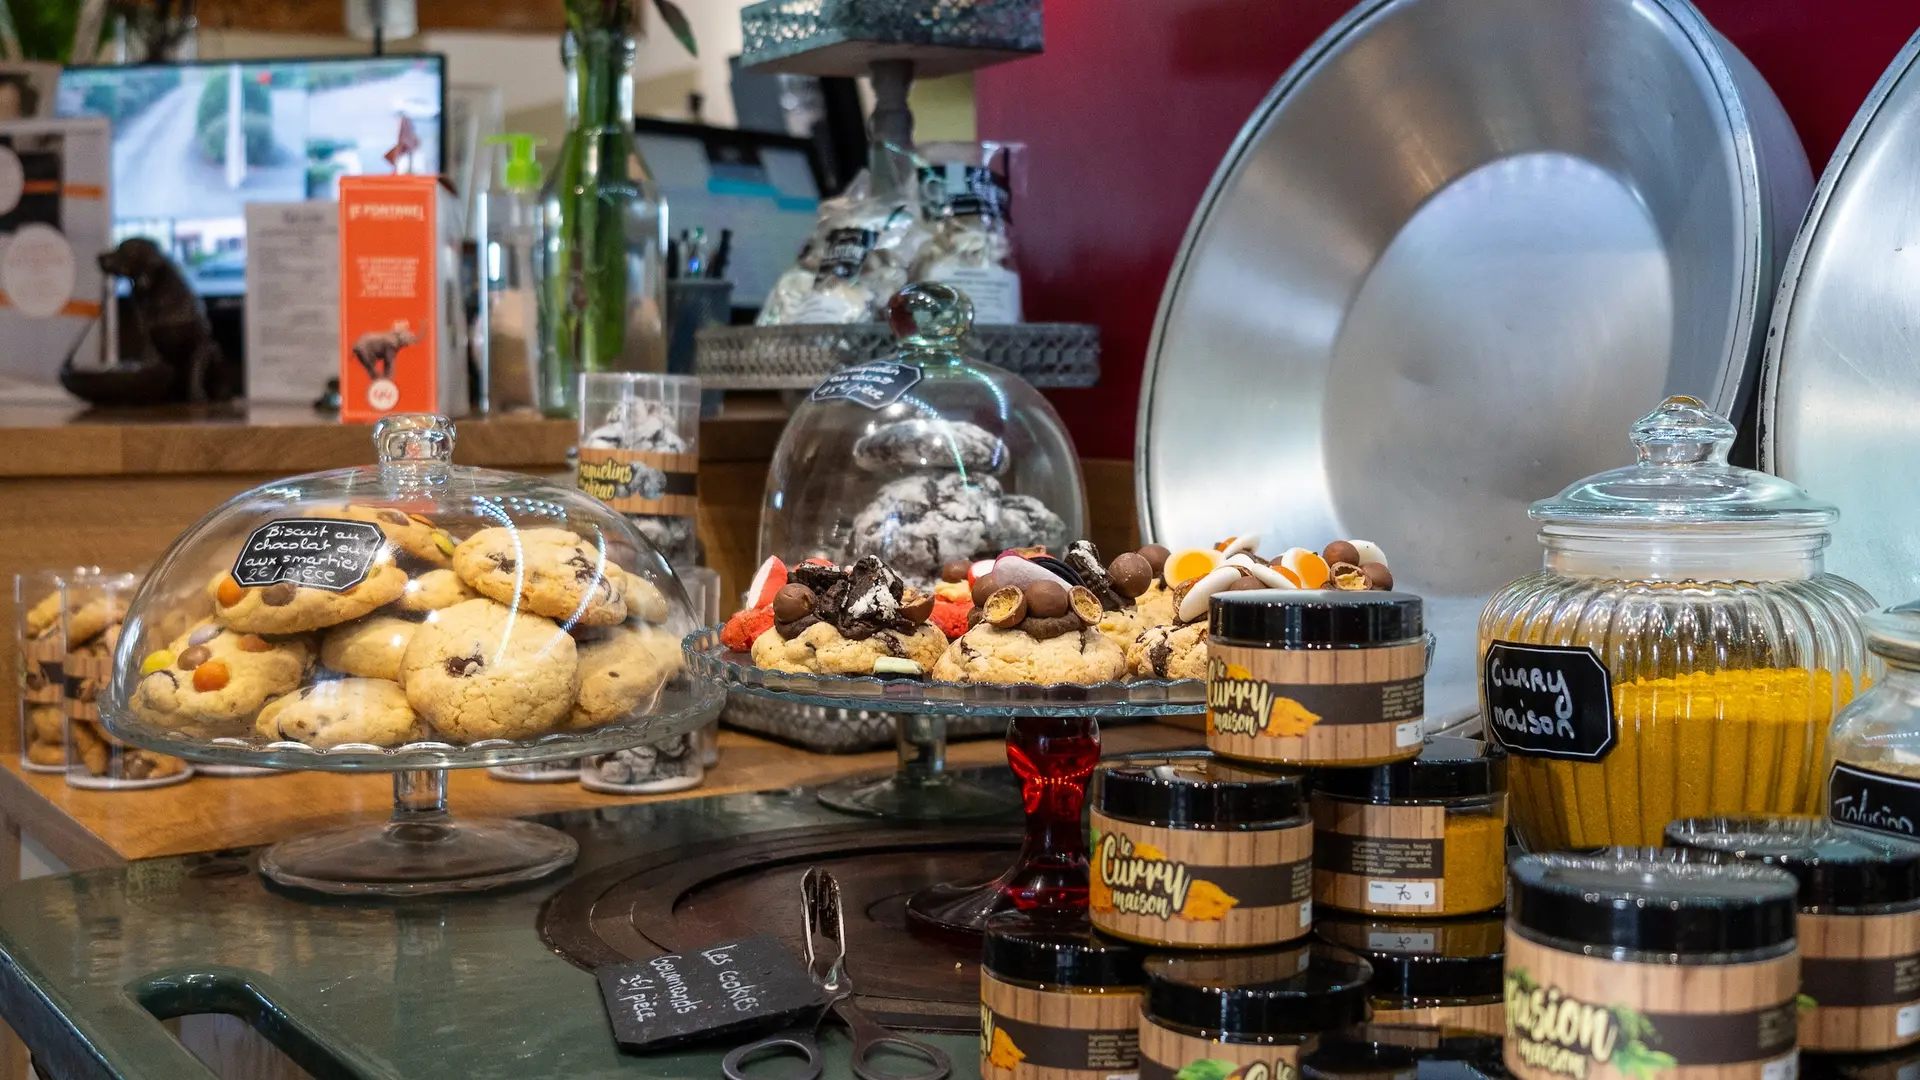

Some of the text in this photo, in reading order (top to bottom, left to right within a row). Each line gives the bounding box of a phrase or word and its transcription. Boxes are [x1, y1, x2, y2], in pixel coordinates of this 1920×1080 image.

[254, 537, 332, 552] chocolat
[265, 525, 360, 540] Biscuit au
[245, 553, 359, 572] aux smarties
[1208, 658, 1275, 729] Curry
[1213, 708, 1259, 737] maison
[1493, 698, 1575, 740] maison
[1101, 834, 1192, 912] Curry
[1112, 889, 1172, 920] maison
[701, 944, 760, 1013] Les cookies
